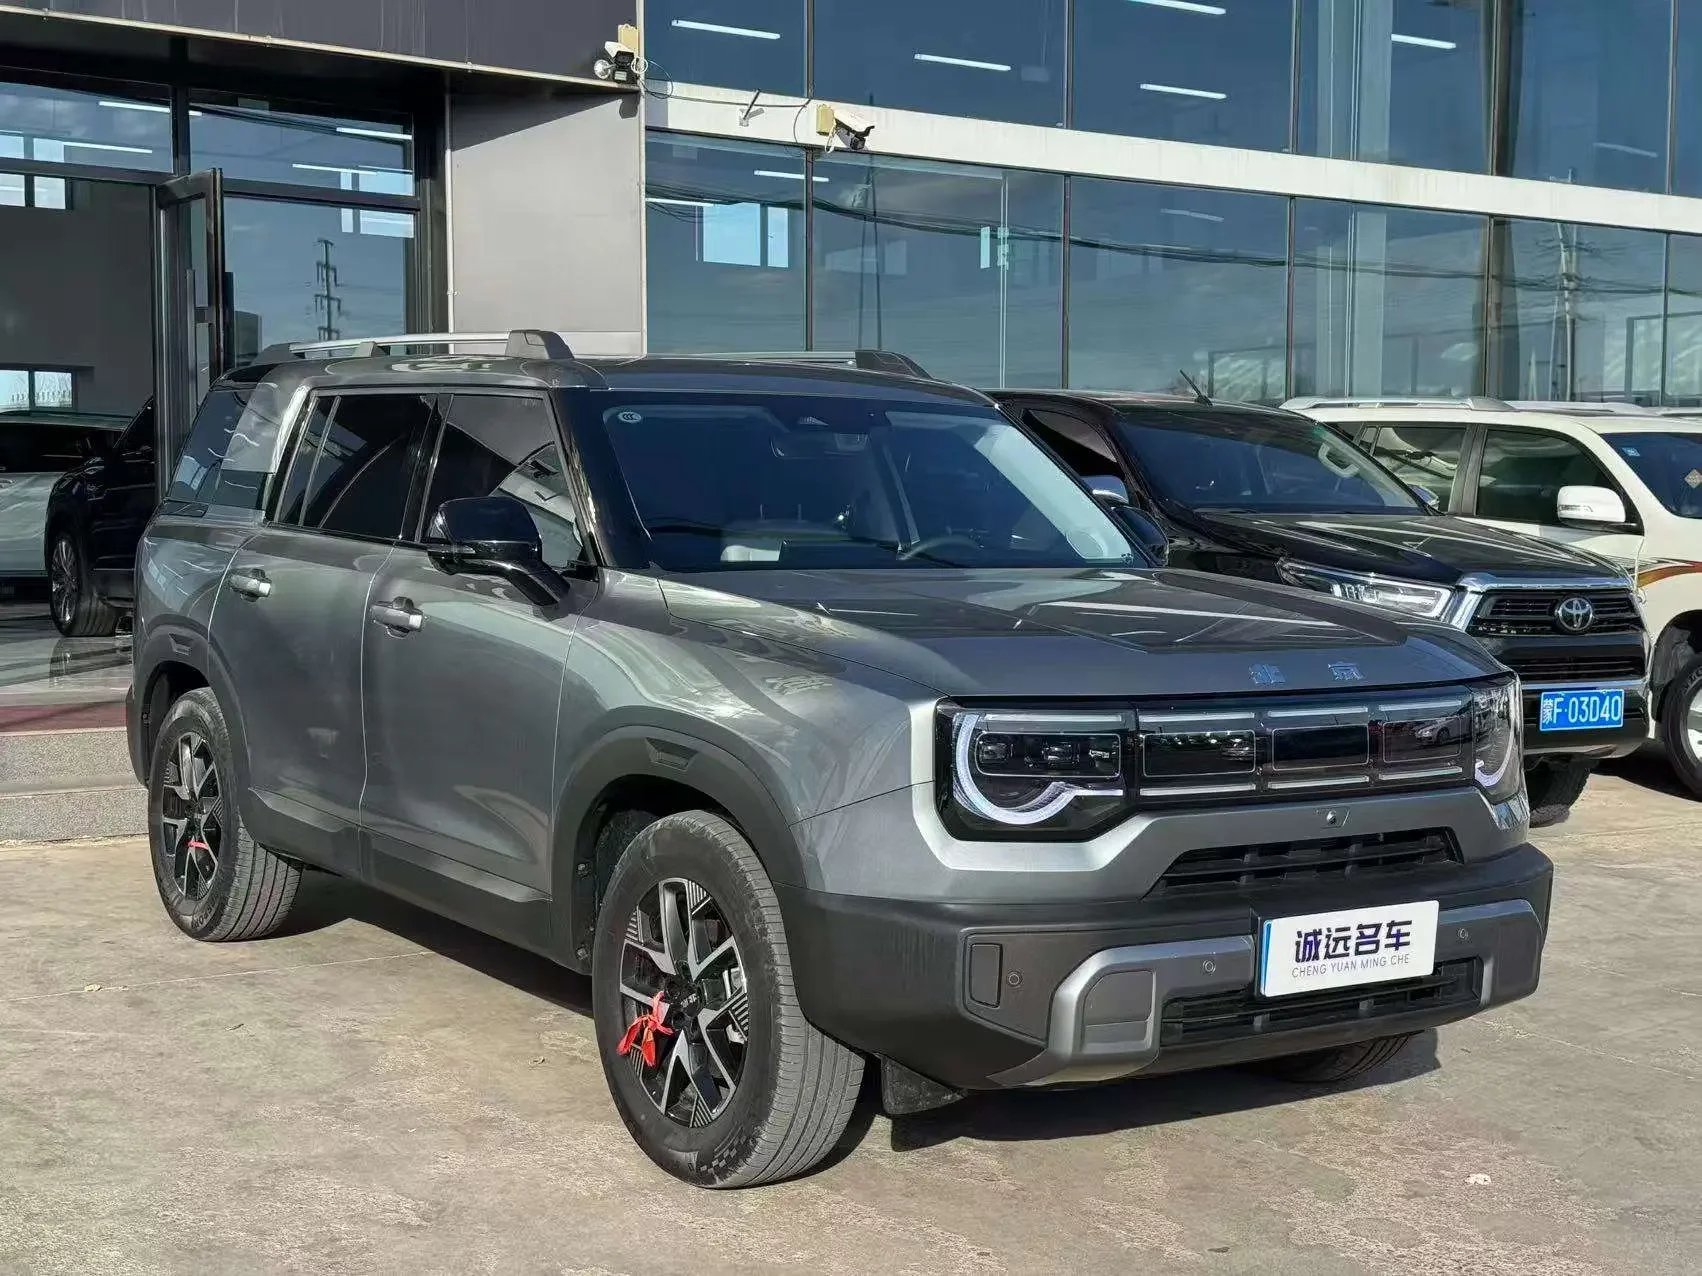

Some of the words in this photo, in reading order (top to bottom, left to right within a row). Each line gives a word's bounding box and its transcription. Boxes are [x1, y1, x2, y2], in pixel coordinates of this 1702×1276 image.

[1294, 920, 1412, 963] 诚远名车
[1291, 964, 1327, 978] CHENG
[1330, 961, 1357, 973] YUAN
[1360, 956, 1387, 969] MING
[1390, 953, 1410, 966] CHE
